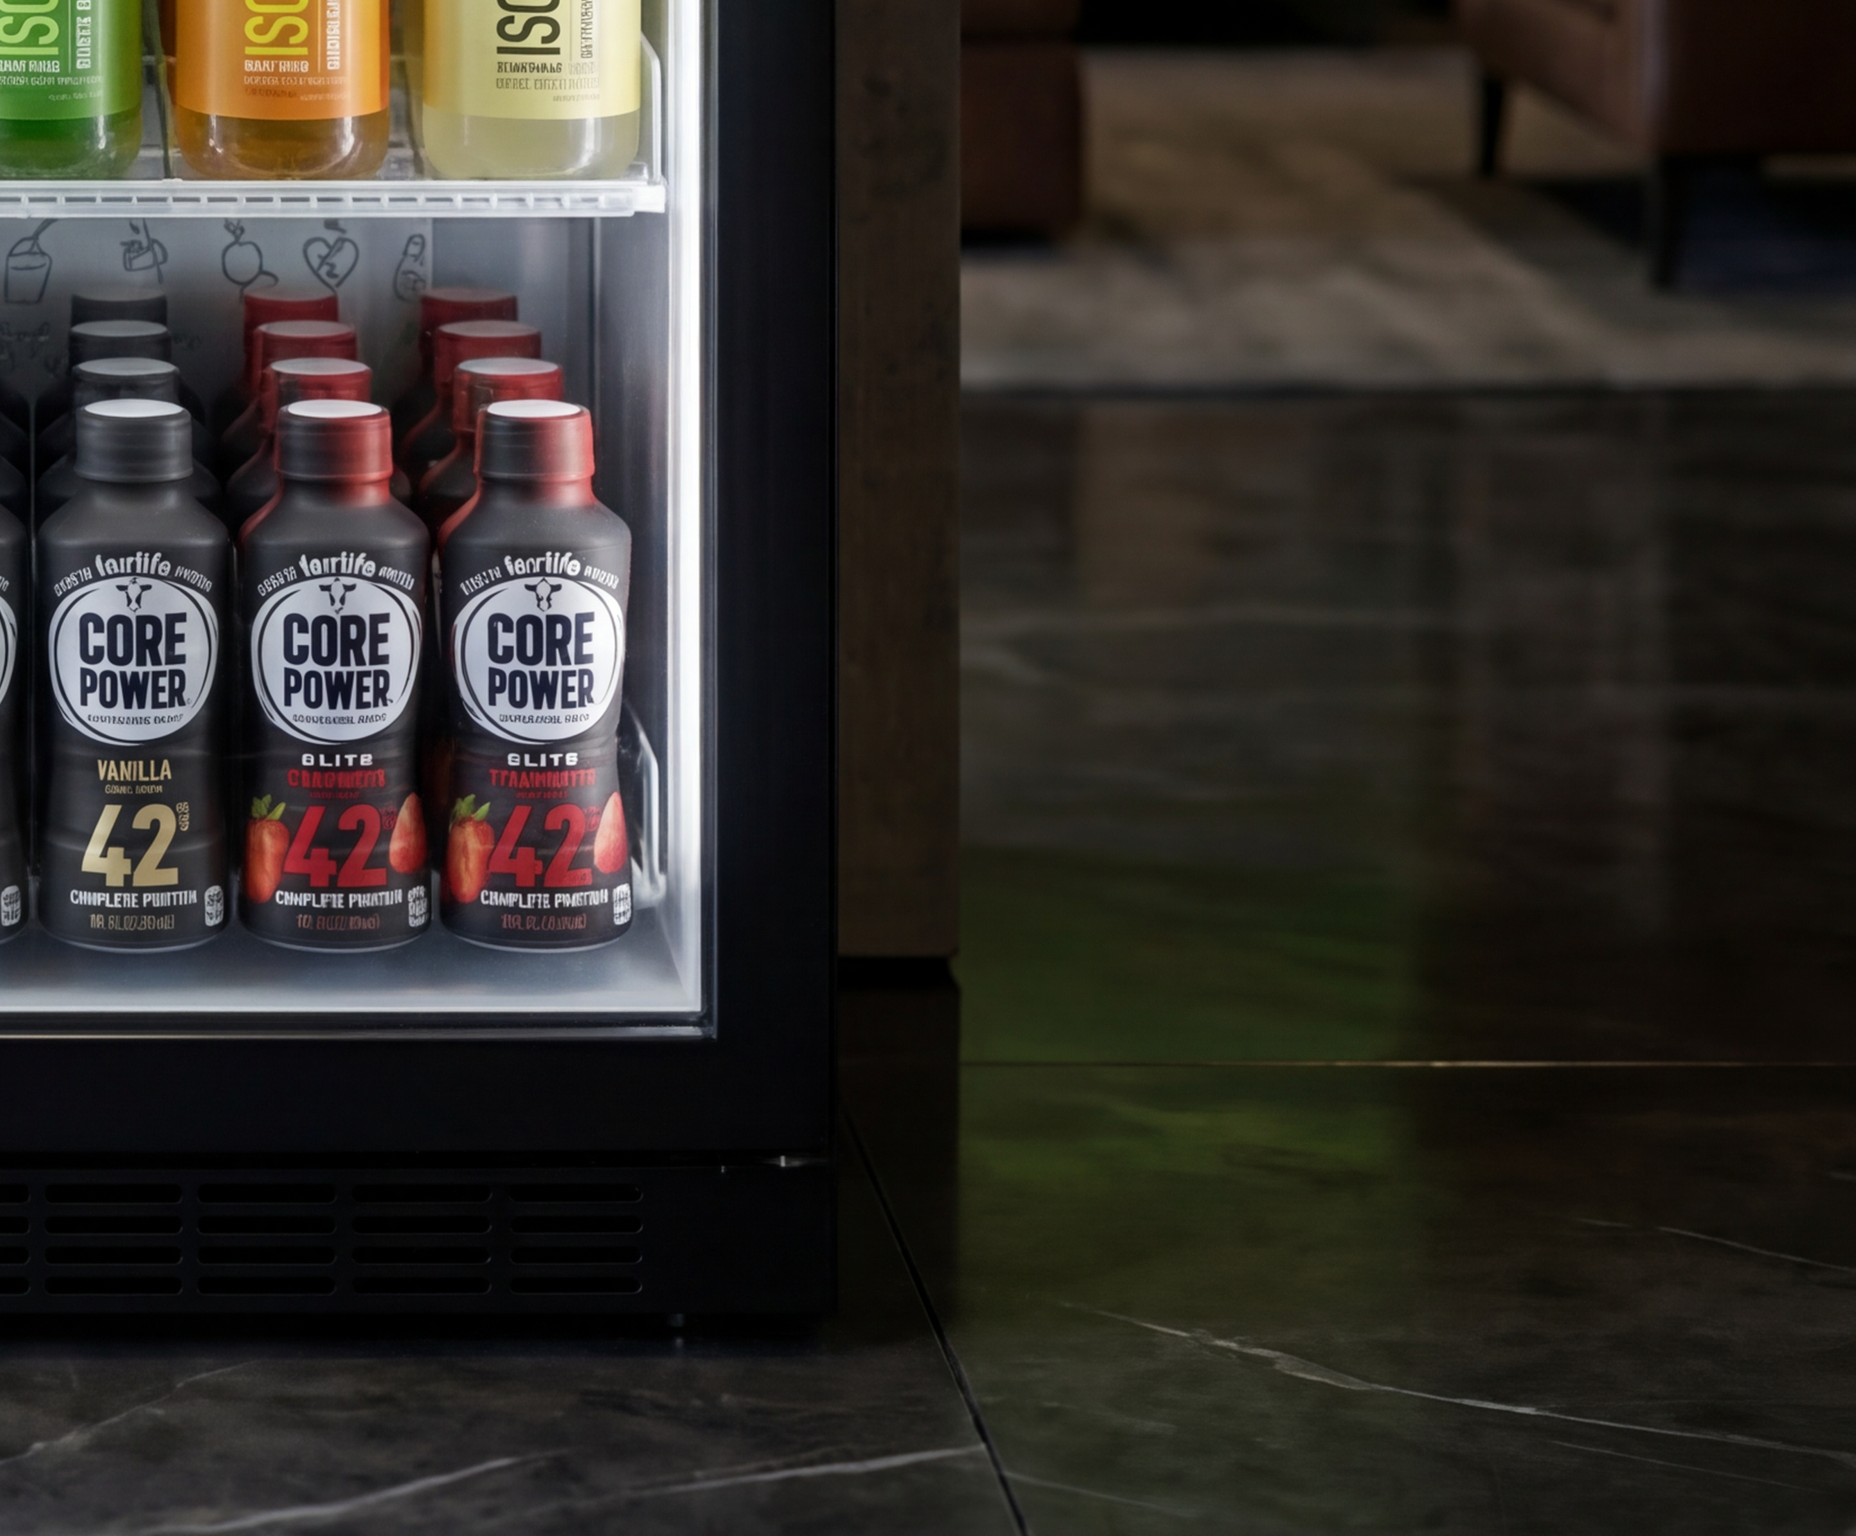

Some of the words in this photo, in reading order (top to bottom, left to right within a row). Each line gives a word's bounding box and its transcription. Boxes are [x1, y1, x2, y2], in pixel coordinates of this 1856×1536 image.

[79, 611, 188, 667] CORE
[282, 611, 391, 667] CORE
[487, 611, 595, 667] CORE
[79, 666, 187, 710] POWER
[283, 666, 391, 710] POWER
[488, 666, 595, 710] POWER
[97, 757, 173, 782] VANILLA
[81, 803, 179, 887] 42
[283, 803, 388, 887] 42
[488, 803, 593, 887] 42
